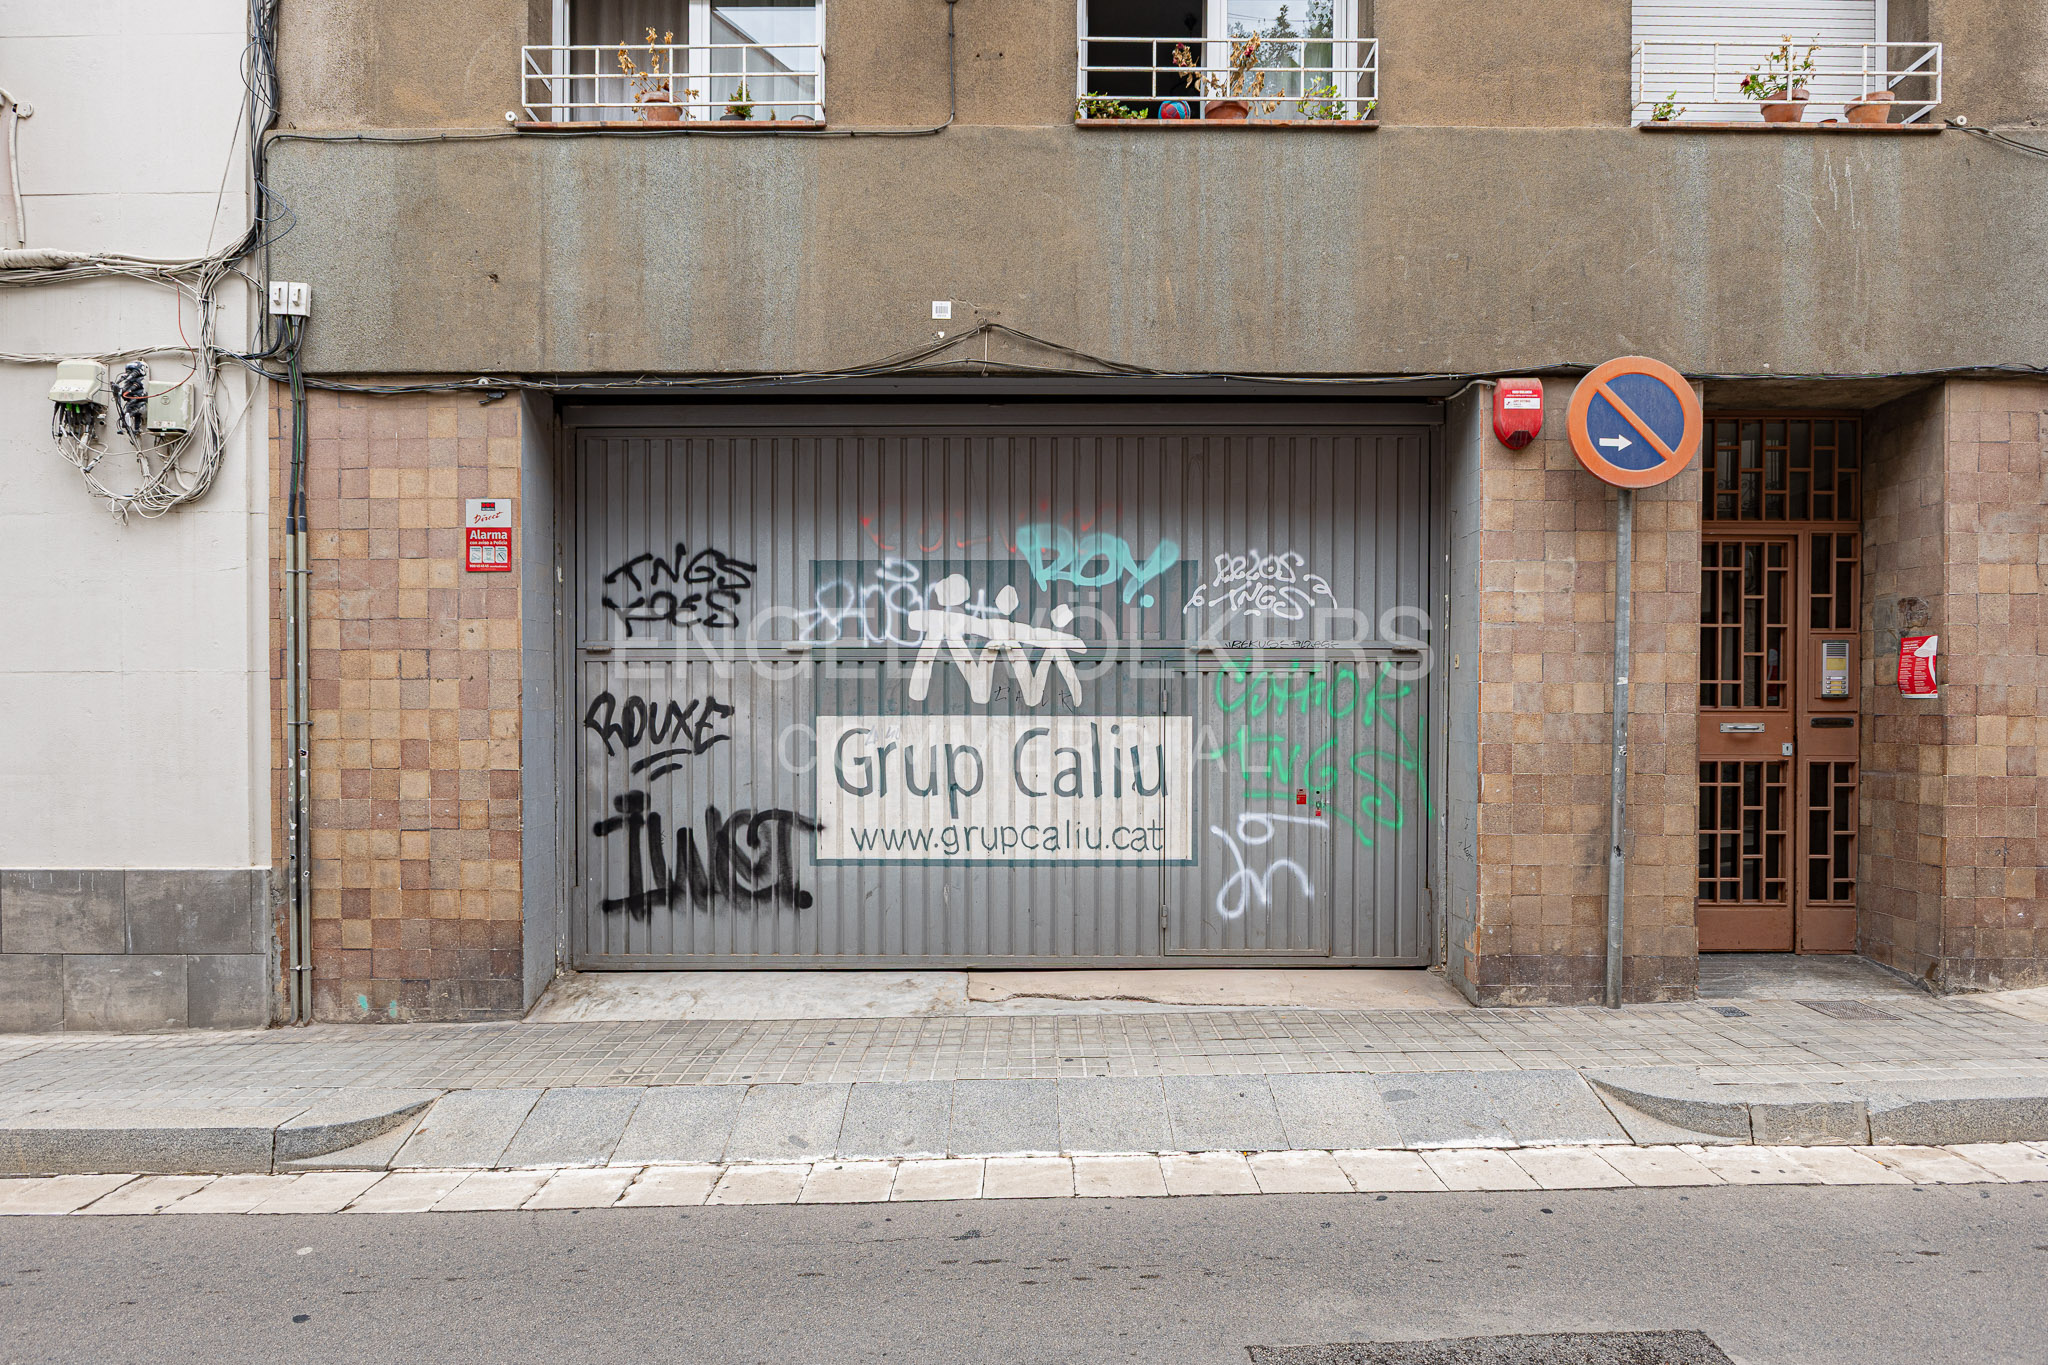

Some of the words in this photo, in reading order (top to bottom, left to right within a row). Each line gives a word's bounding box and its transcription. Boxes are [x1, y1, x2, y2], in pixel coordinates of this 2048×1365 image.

[469, 529, 508, 540] Alarma
[834, 726, 984, 819] Grup
[1014, 720, 1169, 799] Caliu
[850, 818, 1164, 855] www.grupcaliu.cat
